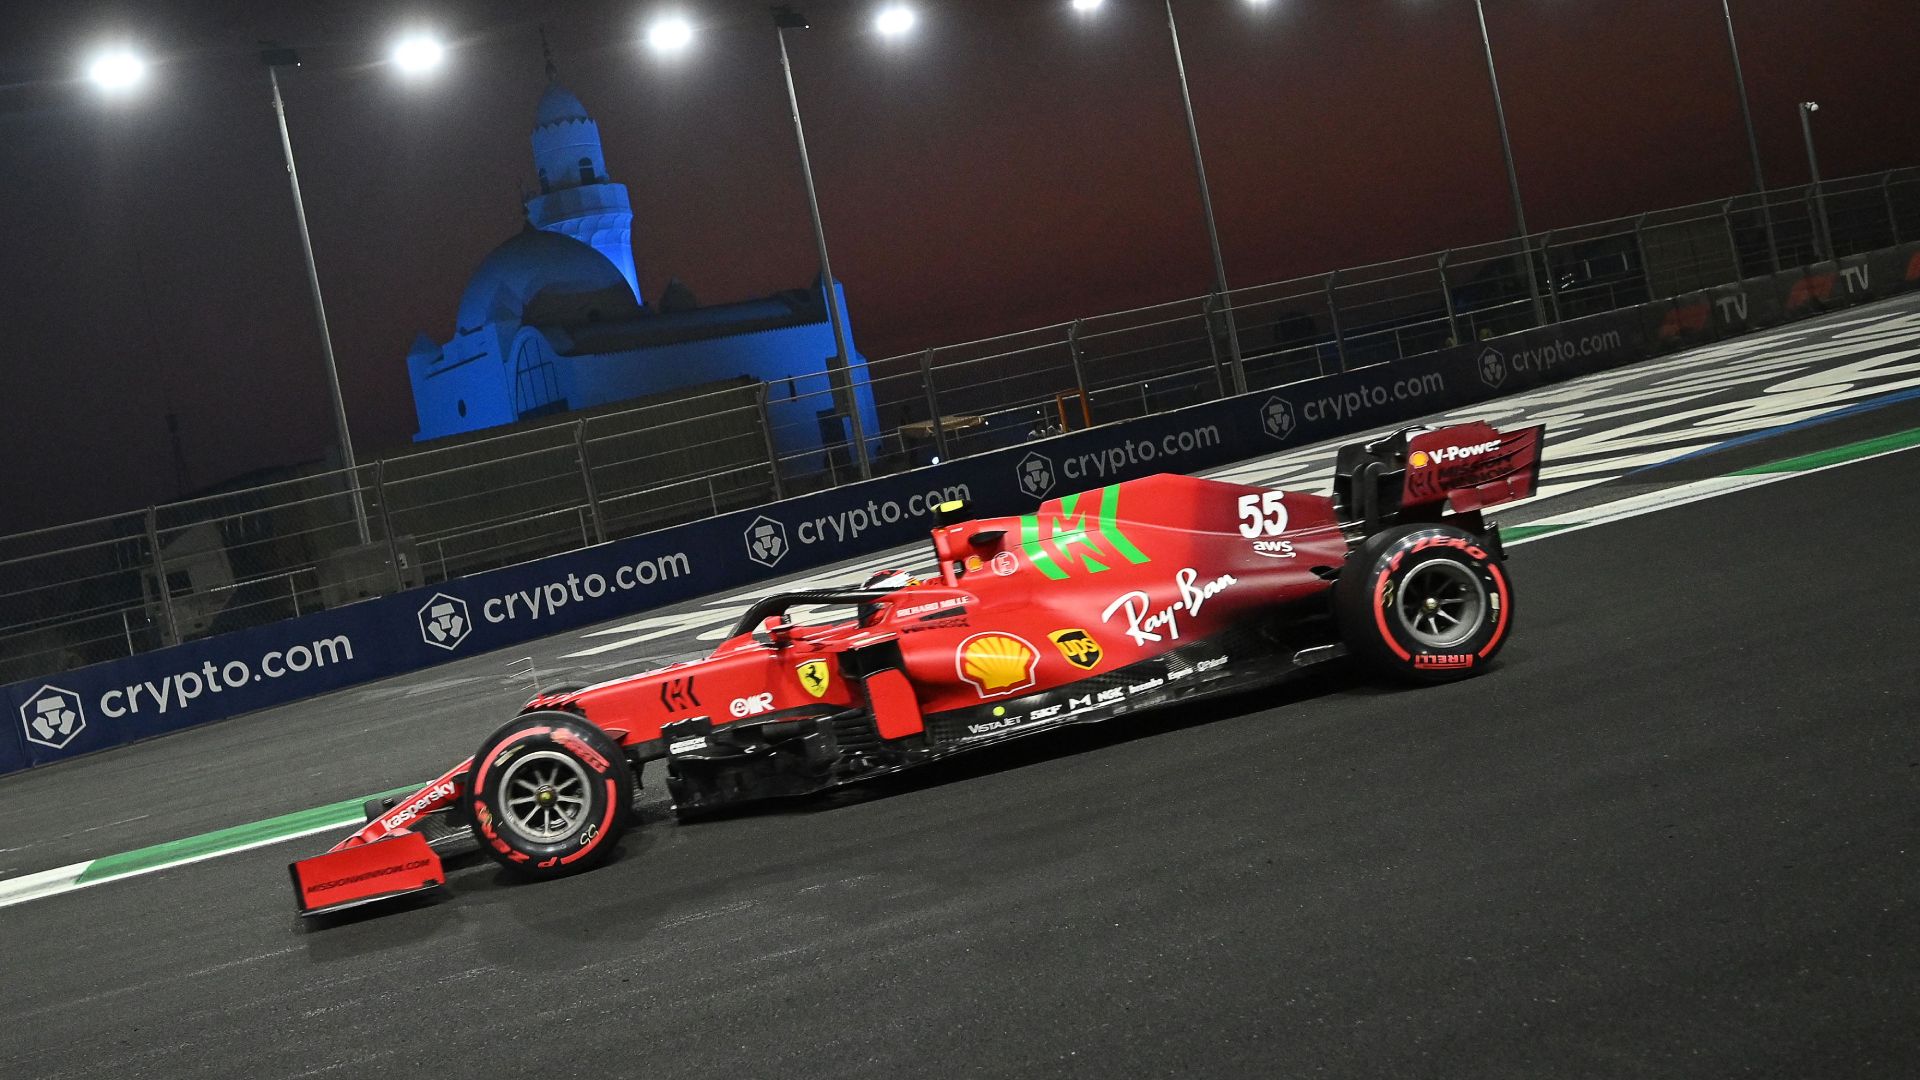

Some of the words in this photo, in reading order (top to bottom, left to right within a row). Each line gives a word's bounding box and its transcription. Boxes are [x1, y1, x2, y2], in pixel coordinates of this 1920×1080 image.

[1839, 263, 1869, 294] TV
[1716, 293, 1748, 324] TV
[1511, 326, 1621, 373] crypto.com
[1303, 369, 1444, 422] crypto.com
[1063, 421, 1220, 480] crypto.com
[1429, 440, 1501, 464] V-Power
[798, 482, 970, 546] crypto.com
[1238, 490, 1289, 539] 55
[1253, 540, 1295, 553] aws
[483, 549, 691, 624] crypto.com
[1101, 567, 1238, 647] Ray-Ban
[1057, 637, 1099, 662] ups
[1414, 653, 1474, 670] PIRELLI
[100, 633, 354, 718] crypto.com
[1030, 704, 1062, 721] SKF
[1097, 686, 1124, 702] NGK
[381, 780, 455, 831] kaspersky
